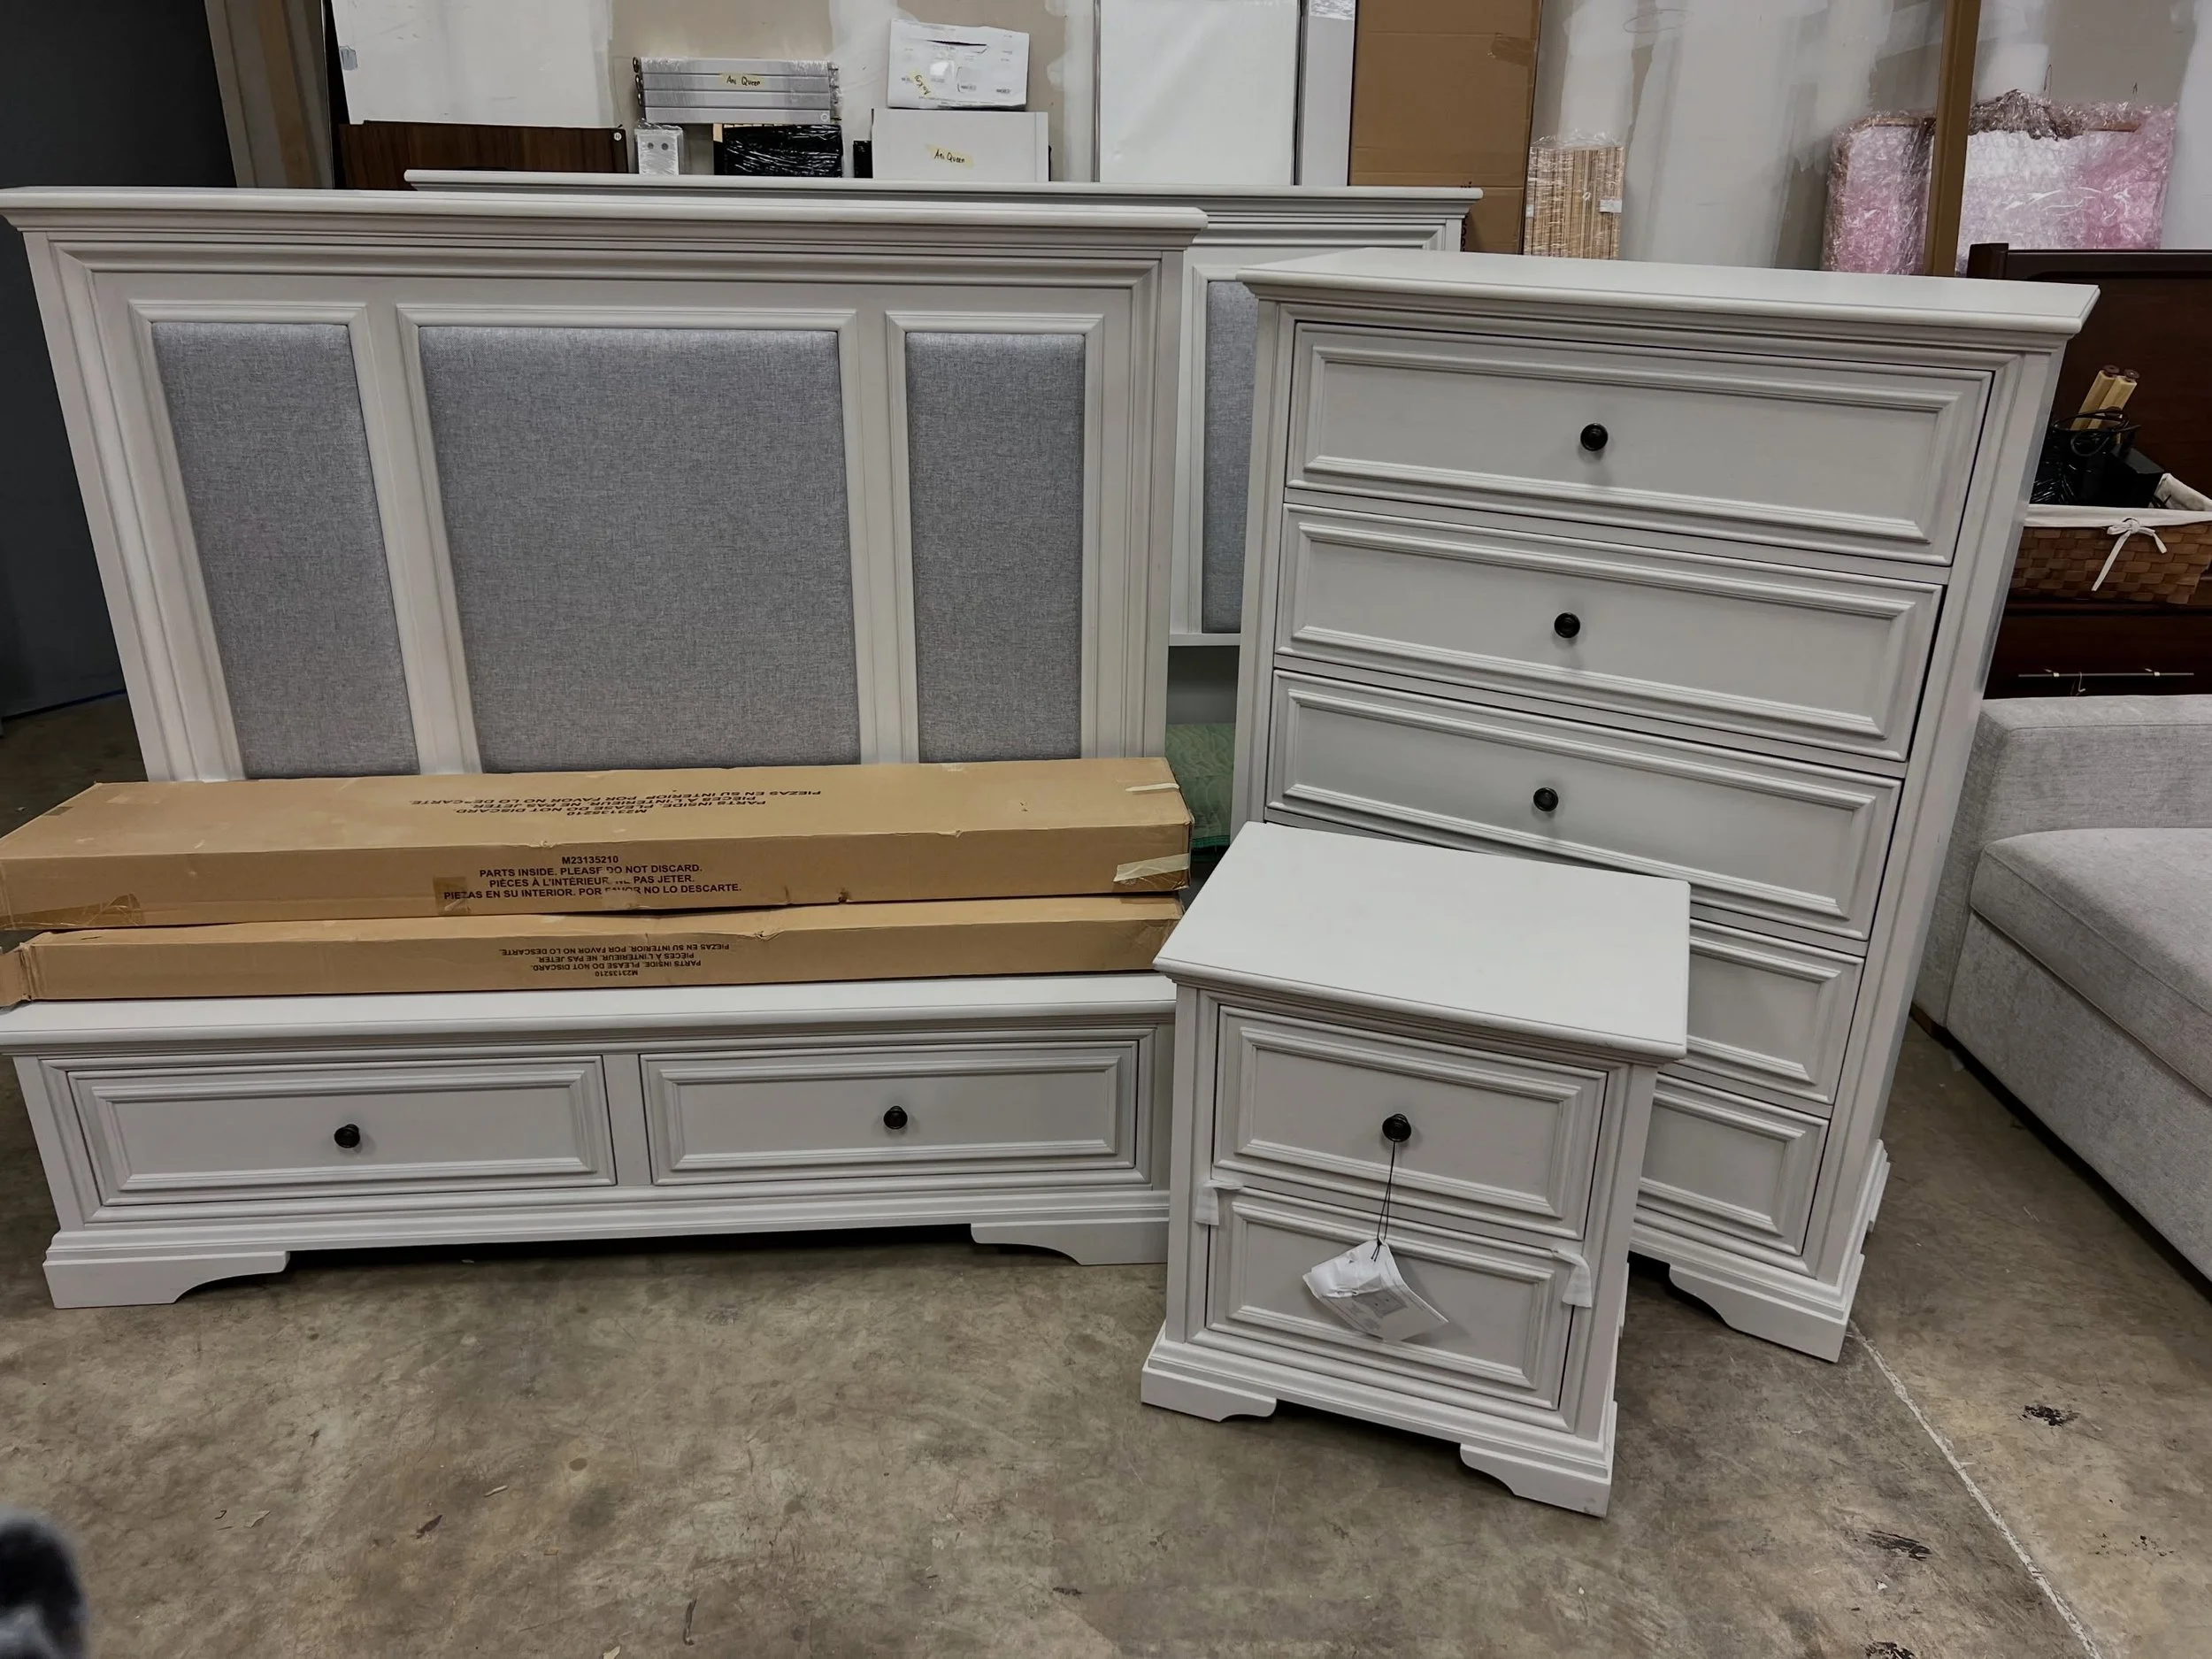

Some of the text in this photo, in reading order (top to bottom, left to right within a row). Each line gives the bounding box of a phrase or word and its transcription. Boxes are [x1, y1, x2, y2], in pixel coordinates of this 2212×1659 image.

[562, 856, 618, 864] M23135210
[480, 868, 515, 877] PARTS
[518, 867, 557, 877] INSIDE.
[626, 865, 648, 874] NOT
[651, 864, 703, 873] DISCARD.
[489, 878, 529, 887] PIÈCES
[532, 878, 540, 887] À
[634, 875, 654, 884] PAS
[657, 874, 695, 883] JETER.
[444, 891, 482, 900] PIEZAS
[522, 888, 575, 897] INTERIOR.
[663, 885, 678, 894] LO
[681, 884, 741, 893] DESCARTE.
